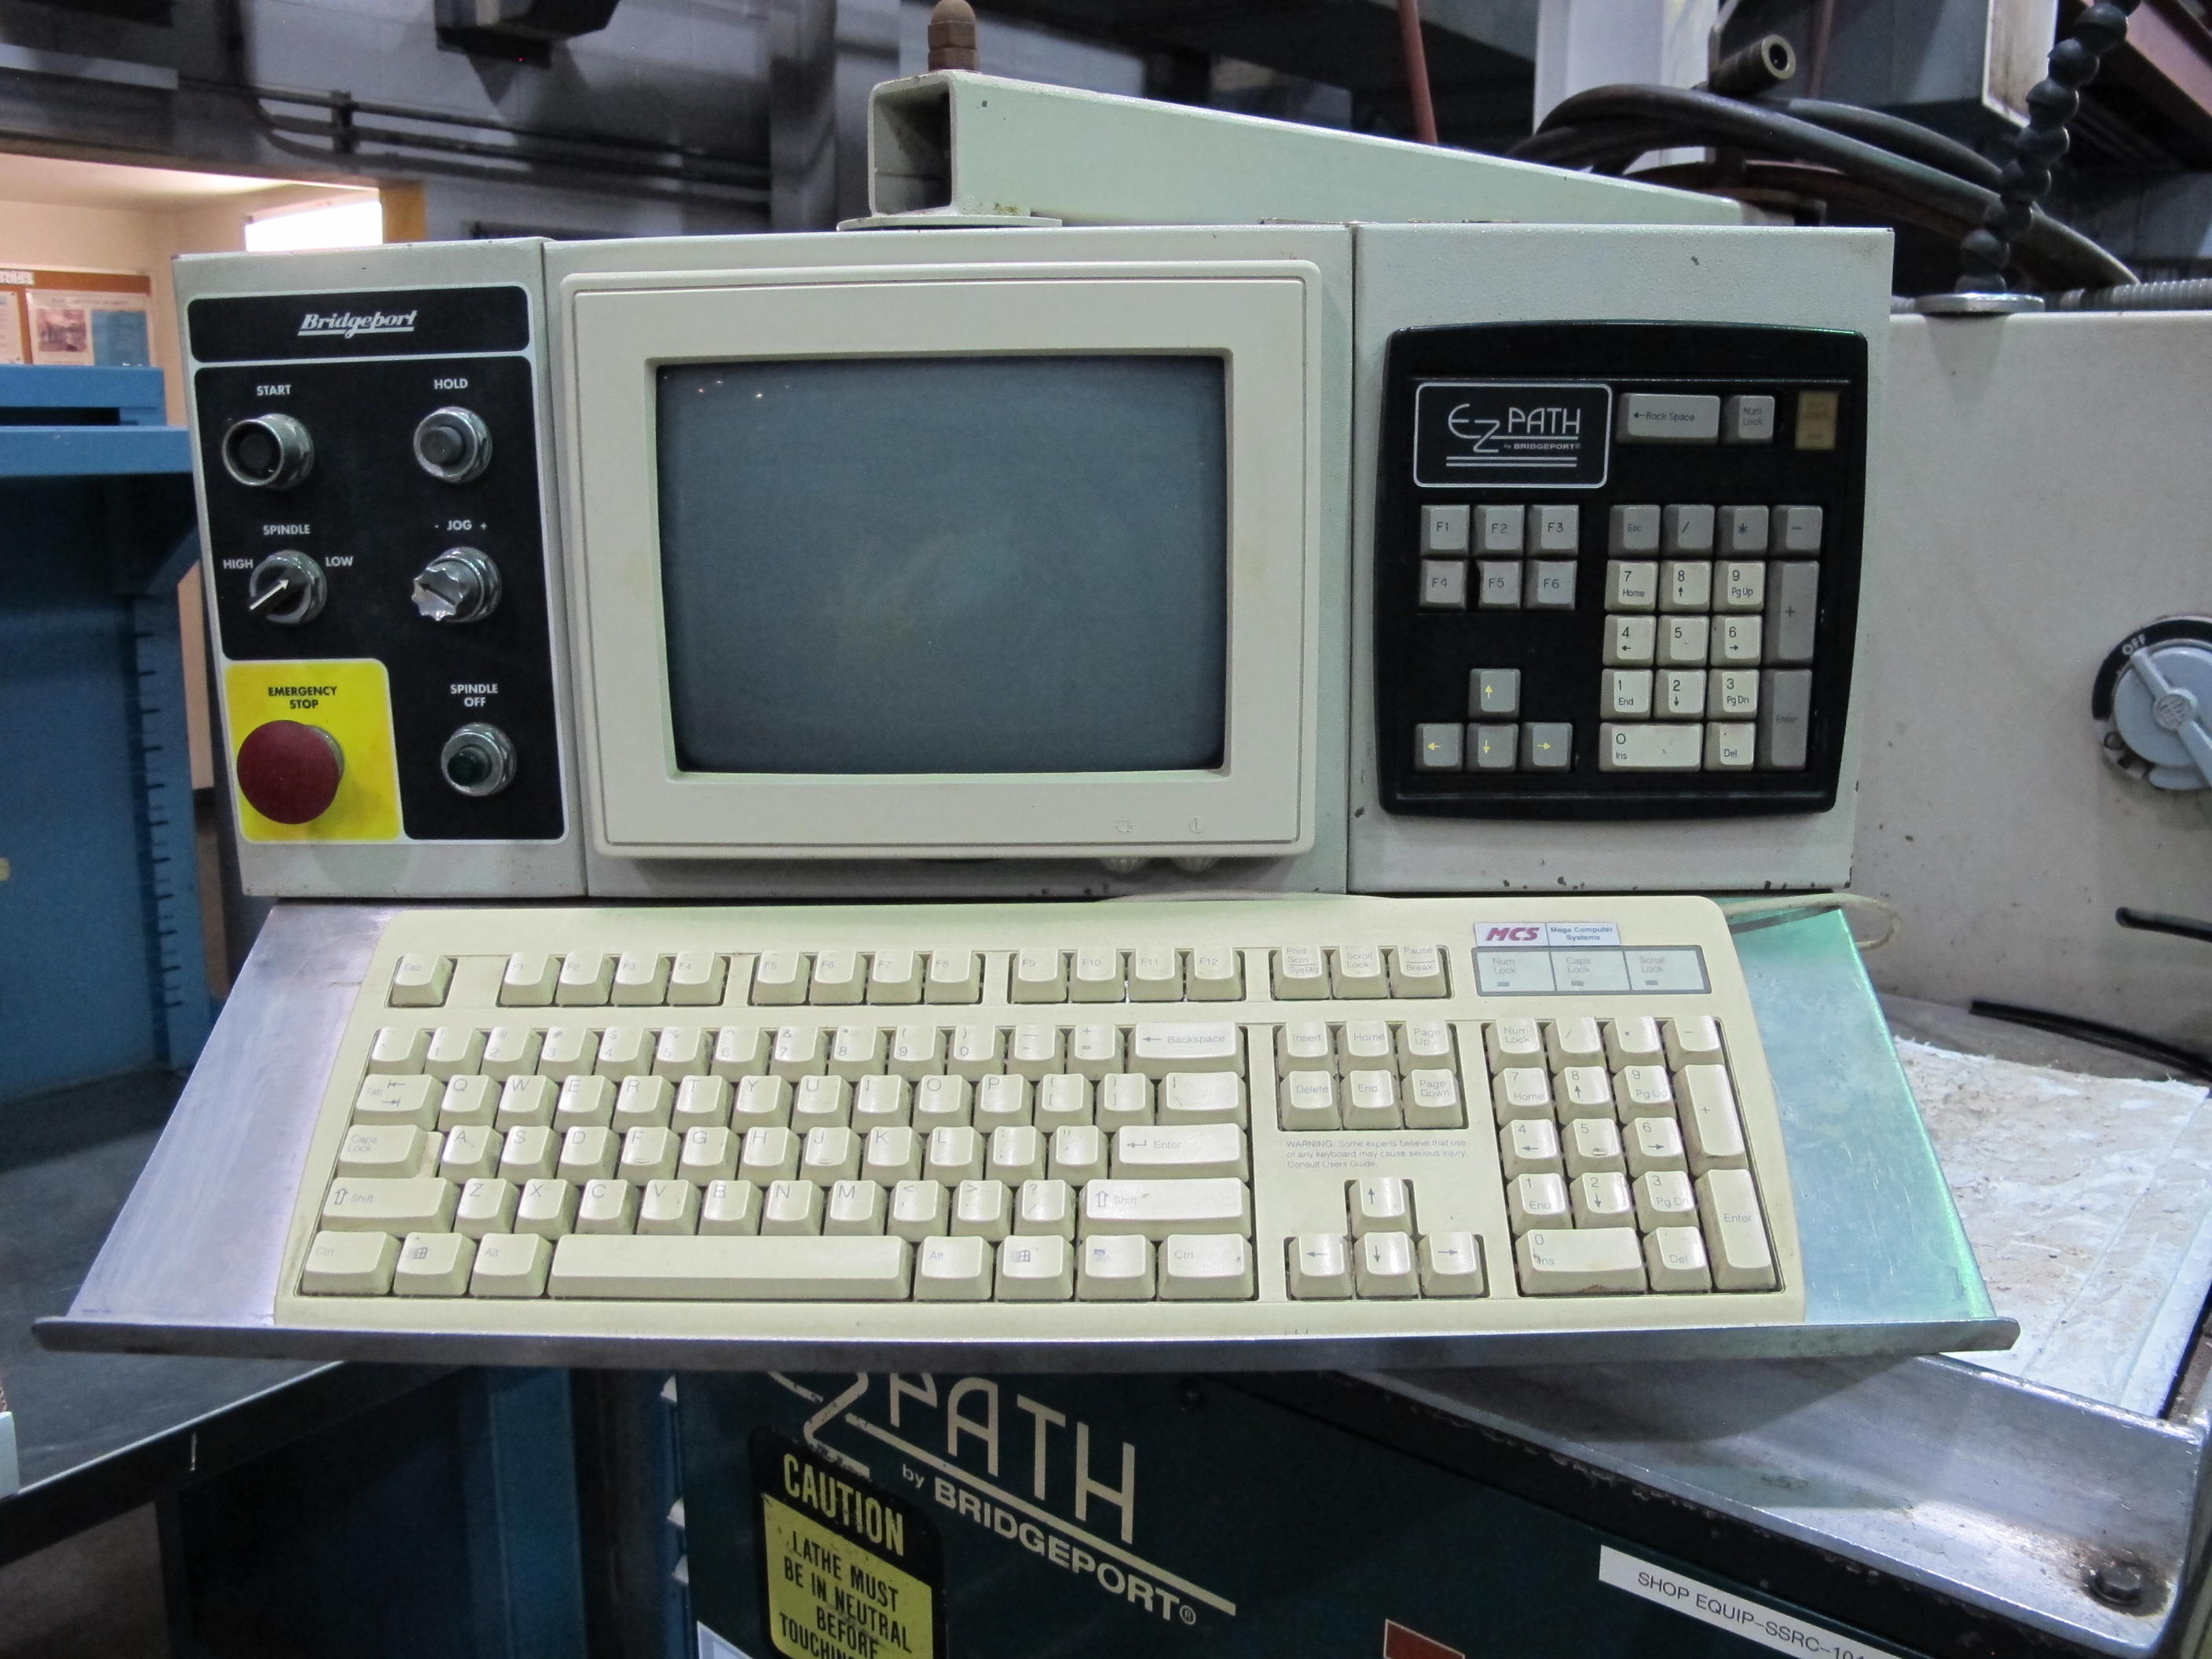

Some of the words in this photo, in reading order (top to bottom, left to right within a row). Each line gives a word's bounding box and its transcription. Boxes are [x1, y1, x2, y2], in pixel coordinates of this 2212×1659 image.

[300, 310, 418, 339] Bridgeport
[434, 378, 469, 390] HOLD
[256, 384, 291, 397] START
[1742, 407, 1762, 416] Num
[1668, 412, 1695, 423] Space
[1741, 417, 1764, 427] Lock
[1448, 403, 1501, 453] EZ
[1507, 406, 1581, 434] PATH
[262, 524, 310, 536] SPINDLE
[447, 519, 472, 532] JOG
[1436, 522, 1450, 533] F1
[1491, 523, 1507, 534] F2
[1547, 522, 1564, 533] F3
[1627, 523, 1643, 533] Esc
[222, 558, 255, 570] HIGH
[325, 555, 353, 568] LOW
[1624, 570, 1632, 582] 7
[1676, 570, 1685, 582] 8
[1731, 570, 1740, 581] 9
[1431, 578, 1448, 589] F4
[1489, 578, 1505, 589] F5
[1543, 579, 1560, 589] F6
[1622, 588, 1645, 598] Home
[1621, 627, 1630, 638] 4
[1674, 628, 1683, 639] 5
[1728, 626, 1737, 638] 6
[2122, 633, 2146, 656] OFF
[449, 683, 499, 695] SPINDLE
[1672, 679, 1681, 691] 2
[1726, 679, 1734, 690] 3
[268, 686, 337, 698] EMERGENCY
[289, 698, 319, 710] STOP
[463, 696, 487, 708] OFF
[1618, 697, 1634, 706] End
[1615, 733, 1626, 745] 0
[1615, 751, 1628, 760] Ins
[1723, 749, 1738, 758] Del
[1485, 927, 1540, 942] MCS
[1550, 927, 1572, 936] Mega
[1573, 926, 1613, 936] Computer
[1566, 934, 1601, 943] Systems
[1141, 958, 1159, 966] F11
[1199, 957, 1219, 966] F12
[1346, 952, 1373, 961] Scroll
[1492, 957, 1515, 965] Num
[1566, 957, 1591, 966] Caps
[1639, 956, 1665, 965] Scroll
[764, 961, 778, 969] F5
[821, 960, 835, 969] F6
[878, 960, 892, 969] F7
[1082, 958, 1102, 967] F10
[1494, 965, 1517, 975] Lock
[1567, 965, 1590, 974] Lock
[1642, 965, 1664, 973] Lock
[1414, 1027, 1441, 1038] Page
[1503, 1026, 1529, 1035] Num
[1167, 1034, 1225, 1046] Backspace
[1293, 1034, 1321, 1042] Insert
[1353, 1033, 1385, 1042] Home
[1414, 1038, 1430, 1046] Up
[1505, 1035, 1530, 1044] Lock
[452, 1079, 468, 1093] Q
[511, 1079, 529, 1093] W
[568, 1079, 581, 1093] E
[626, 1079, 640, 1093] R
[687, 1079, 701, 1093] T
[746, 1079, 760, 1093] Y
[804, 1079, 821, 1093] U
[926, 1079, 943, 1093] O
[988, 1079, 1002, 1093] P
[1296, 1084, 1329, 1094] Delete
[1357, 1084, 1378, 1093] End
[1419, 1079, 1446, 1090] Page
[1420, 1089, 1450, 1097] Down
[1513, 1090, 1545, 1101] Home
[351, 1133, 379, 1145] Caps
[454, 1130, 467, 1142] A
[513, 1130, 527, 1144] S
[570, 1130, 586, 1144] D
[631, 1130, 644, 1144] F
[692, 1130, 709, 1145] G
[752, 1130, 768, 1145] H
[813, 1130, 825, 1145] J
[874, 1130, 889, 1144] K
[347, 1144, 372, 1152] Lock
[1152, 1139, 1181, 1150] Enter
[1365, 1140, 1397, 1150] experts
[1298, 1151, 1313, 1160] any
[1315, 1150, 1357, 1159] keyboard
[1359, 1151, 1378, 1159] may
[468, 1184, 484, 1198] Z
[530, 1184, 545, 1198] X
[591, 1184, 607, 1198] C
[653, 1184, 666, 1198] V
[712, 1184, 727, 1198] B
[775, 1184, 791, 1198] N
[838, 1184, 856, 1198] M
[350, 1192, 375, 1203] Shift
[1113, 1194, 1137, 1206] Shift
[1529, 1200, 1551, 1210] End
[1723, 1213, 1752, 1223] Enter
[315, 1246, 335, 1256] Ctrl
[484, 1247, 500, 1258] Alt
[928, 1251, 943, 1261] Alt
[1174, 1250, 1195, 1260] Ctrl
[1669, 1254, 1690, 1264] Del
[903, 1463, 925, 1489] by
[783, 1452, 903, 1556] CAUTION
[793, 1531, 843, 1581] LATHE
[851, 1564, 899, 1612] MUST
[1638, 1572, 1690, 1600] SHOP
[784, 1555, 804, 1589] BE
[811, 1573, 827, 1603] IN
[835, 1586, 913, 1654] NEUTRAL
[816, 1606, 879, 1659] BEFORE
